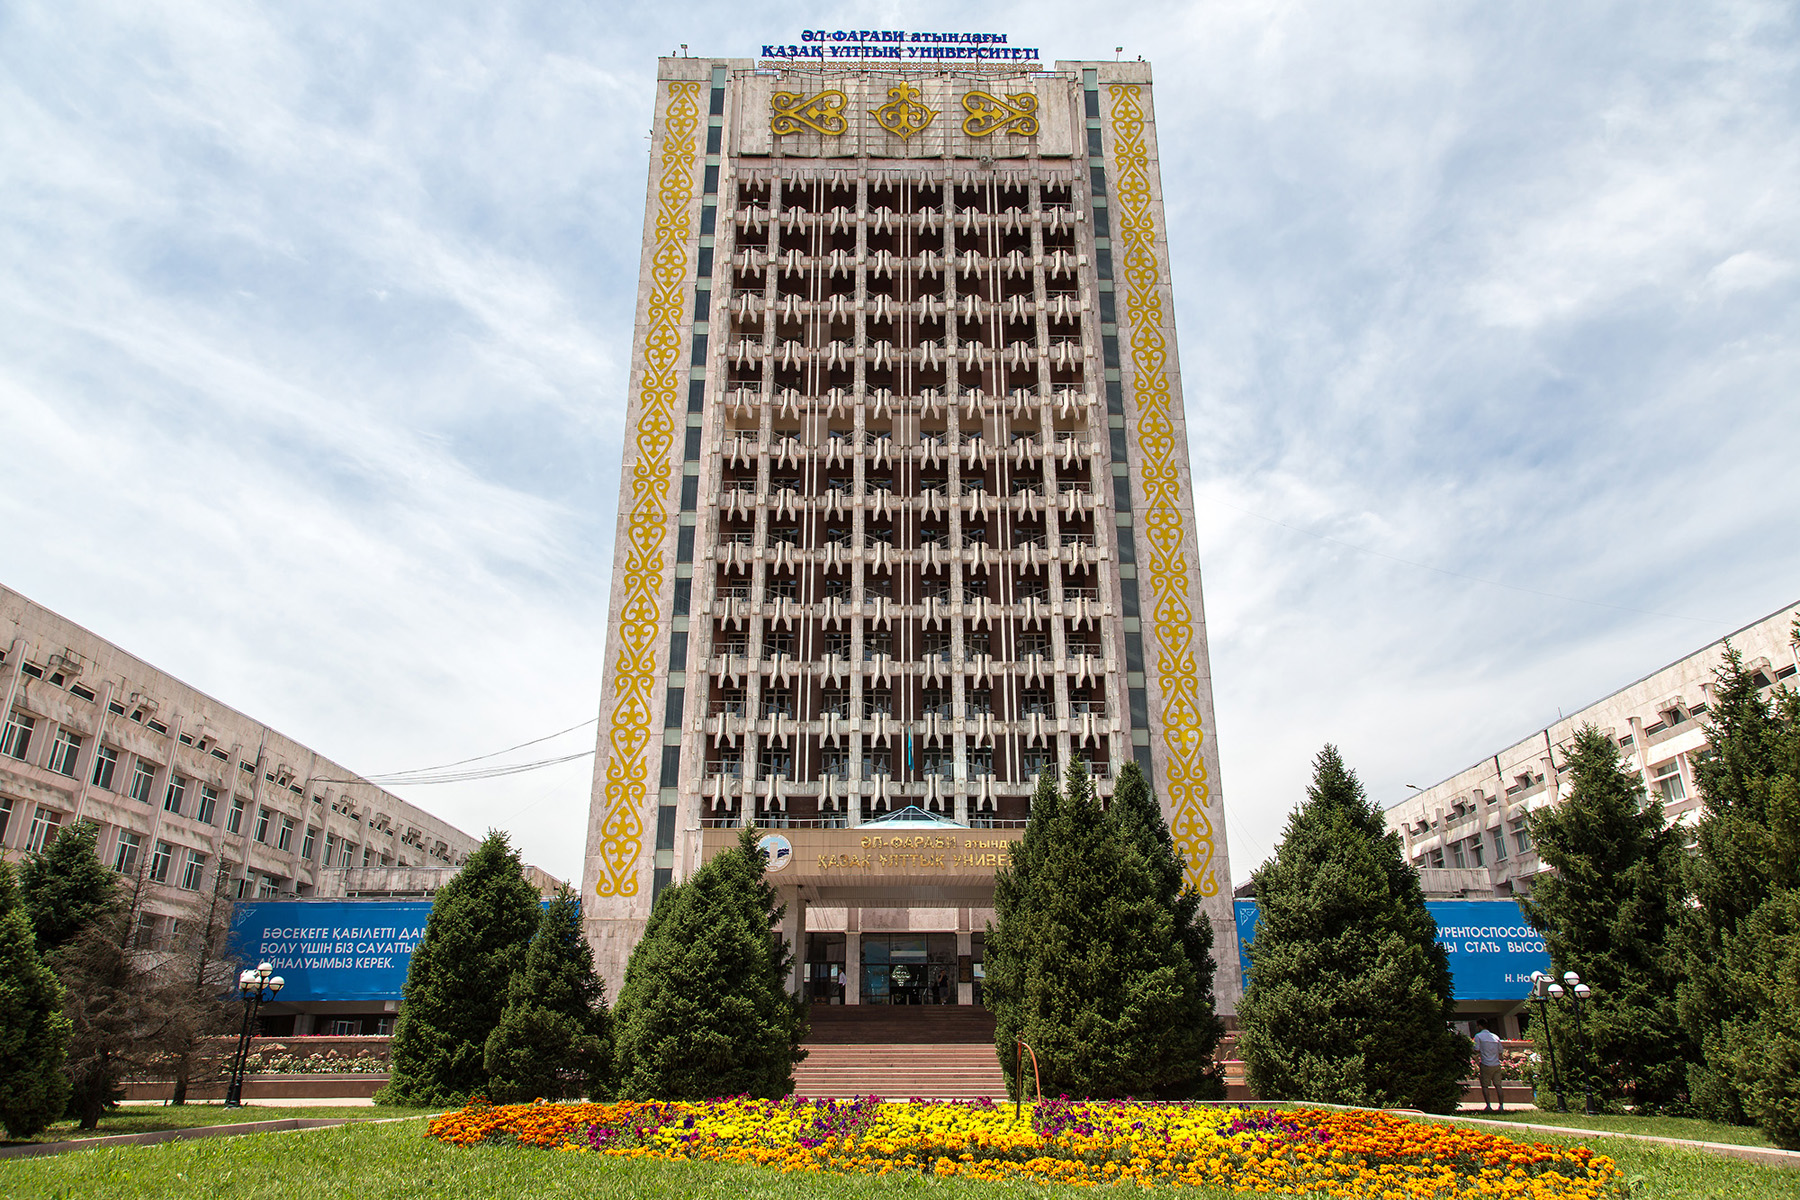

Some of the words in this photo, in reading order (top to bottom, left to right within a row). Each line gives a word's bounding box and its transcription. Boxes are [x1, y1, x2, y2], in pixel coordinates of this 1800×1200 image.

[801, 30, 905, 42] ӘЛ-ФАРАБИ
[911, 32, 1008, 45] атындағы
[761, 45, 823, 59] ҚАЗАҚ
[829, 46, 901, 59] ҰЛТТЫҚ
[907, 47, 1039, 59] УНИВЕРСИТЕТІ
[861, 836, 956, 849] ӘЛ-ФАРАБИ
[964, 840, 1014, 850] атынд
[262, 927, 329, 939] БӘСЕКЕГЕ
[332, 927, 396, 940] ҚАБІЛЕТТІ
[1436, 926, 1541, 938] УРЕНТОСПОСОБ
[260, 942, 298, 954] БОЛУ
[300, 942, 333, 954] ҮШІН
[335, 942, 354, 954] БІЗ
[356, 942, 415, 954] САУАТТЫ
[1464, 941, 1501, 953] СТАТЬ
[1507, 941, 1546, 953] ВЫСО
[355, 957, 395, 969] КЕРЕК.
[1505, 973, 1515, 983] Н.
[1517, 973, 1531, 983] На
